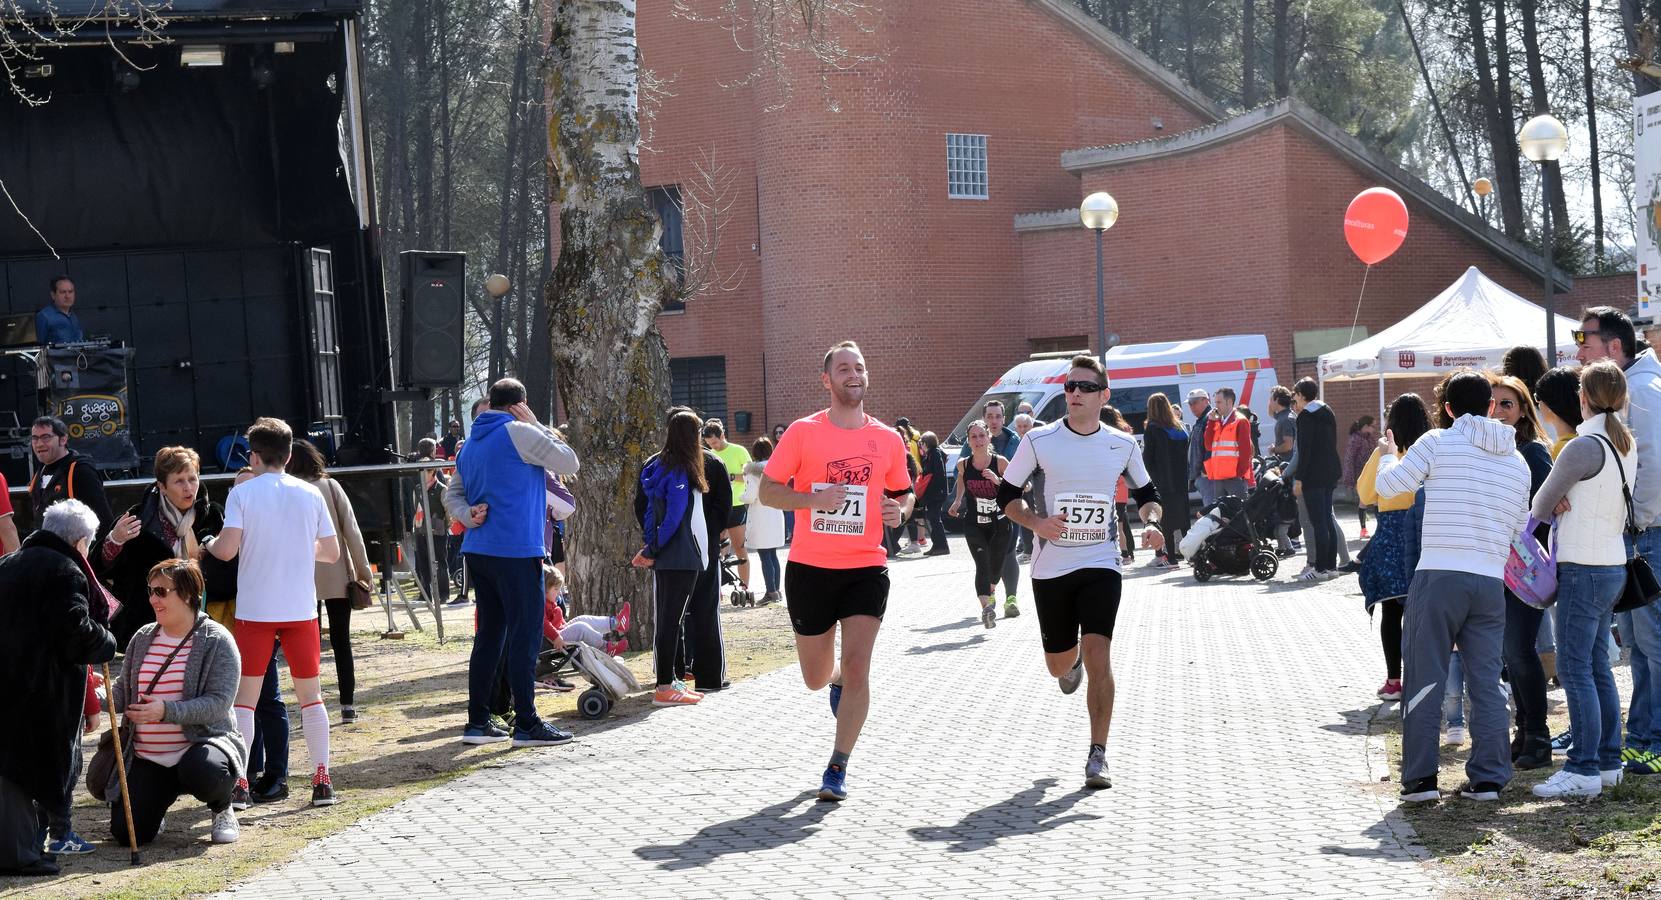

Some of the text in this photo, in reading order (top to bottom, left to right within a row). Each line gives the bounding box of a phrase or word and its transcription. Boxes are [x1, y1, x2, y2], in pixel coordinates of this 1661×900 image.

[1444, 355, 1487, 363] Ayuntamiento
[81, 401, 119, 423] guagua
[1060, 507, 1105, 524] 1573
[825, 524, 863, 533] ATLETISMO
[1069, 532, 1106, 541] ATLETISMO
